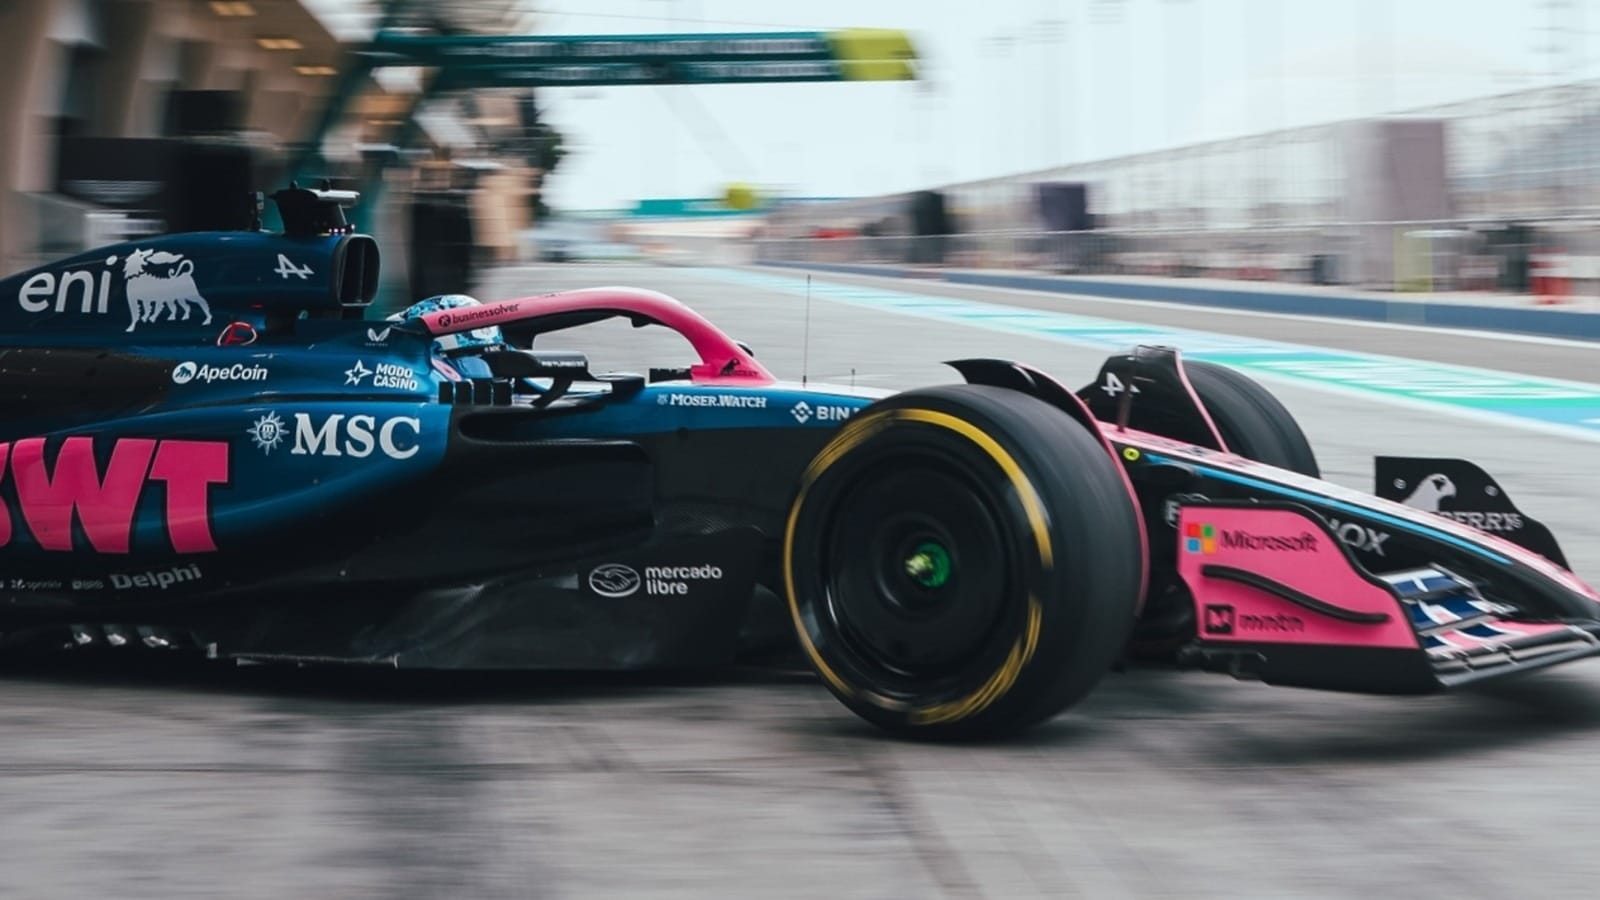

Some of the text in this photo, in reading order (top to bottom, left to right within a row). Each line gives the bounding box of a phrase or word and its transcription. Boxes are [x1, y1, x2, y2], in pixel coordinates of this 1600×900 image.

[18, 255, 118, 313] eni
[452, 303, 520, 324] businessolver
[196, 363, 268, 383] ApeCoin
[376, 363, 413, 379] MODO
[373, 374, 418, 391] CASINO
[291, 412, 421, 460] MSC
[1220, 529, 1319, 553] Microsoft
[110, 563, 202, 589] Delphi
[645, 564, 722, 579] mercado
[646, 580, 689, 595] libre
